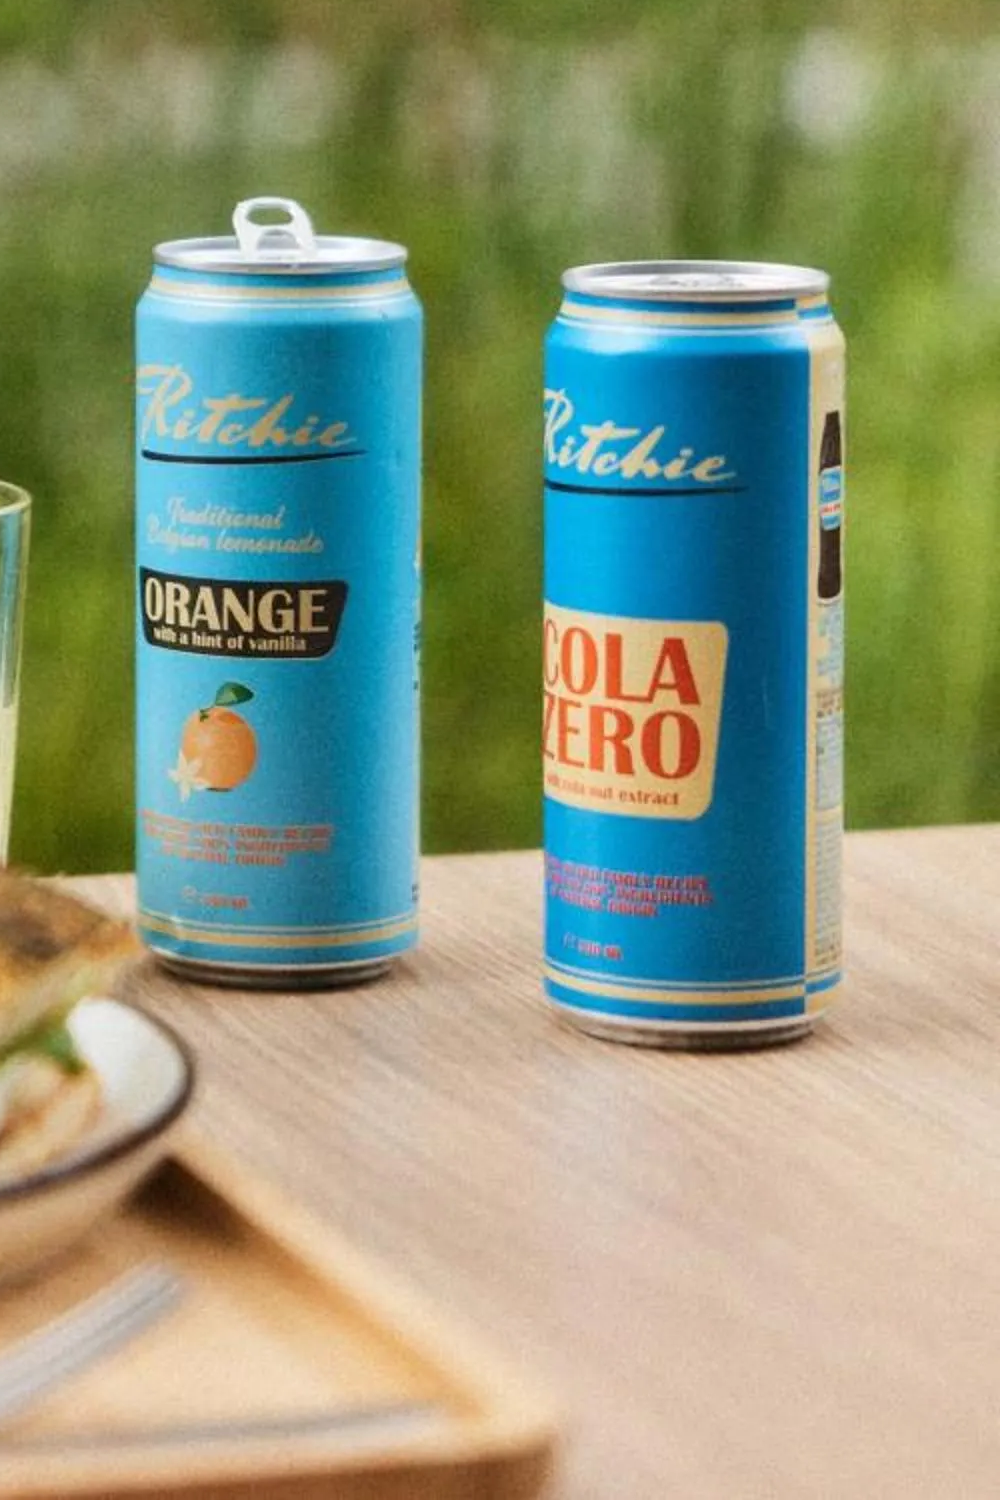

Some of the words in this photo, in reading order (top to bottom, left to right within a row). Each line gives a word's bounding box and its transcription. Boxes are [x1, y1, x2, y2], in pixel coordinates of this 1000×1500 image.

[136, 362, 357, 448] Ritchie
[544, 387, 737, 482] Ritchie
[144, 577, 330, 634] ORANGE
[153, 626, 176, 643] with
[179, 631, 189, 645] a
[192, 630, 221, 649] hint
[227, 634, 245, 651] of
[250, 634, 307, 652] vanilla
[544, 617, 702, 706] COLA
[543, 690, 702, 780] ZERO
[618, 789, 679, 806] extract
